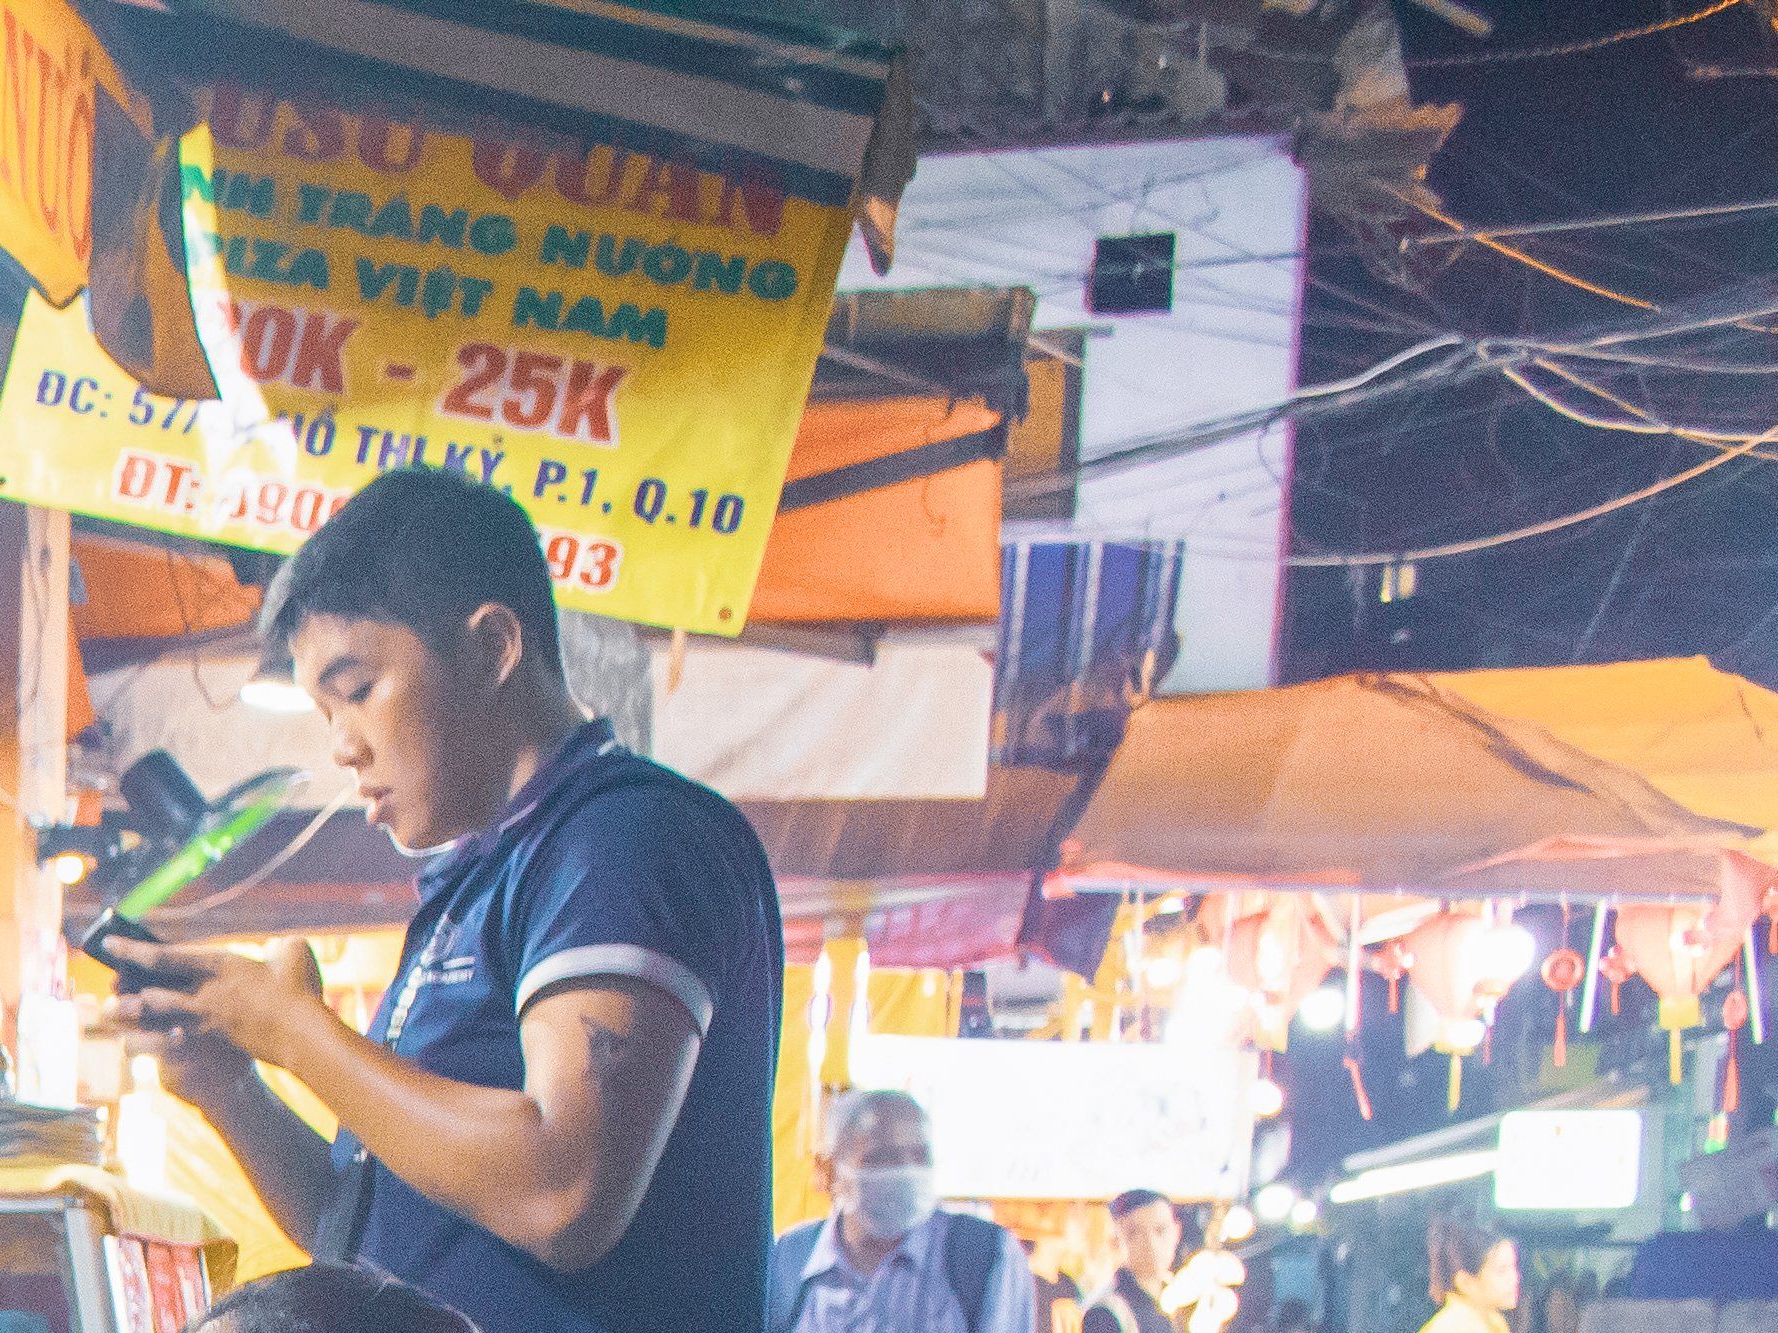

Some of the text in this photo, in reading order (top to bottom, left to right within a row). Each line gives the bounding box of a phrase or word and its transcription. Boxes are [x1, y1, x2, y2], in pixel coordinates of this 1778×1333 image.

[512, 287, 668, 350] NAM
[441, 342, 626, 443] 25K
[634, 477, 746, 535] Q.10
